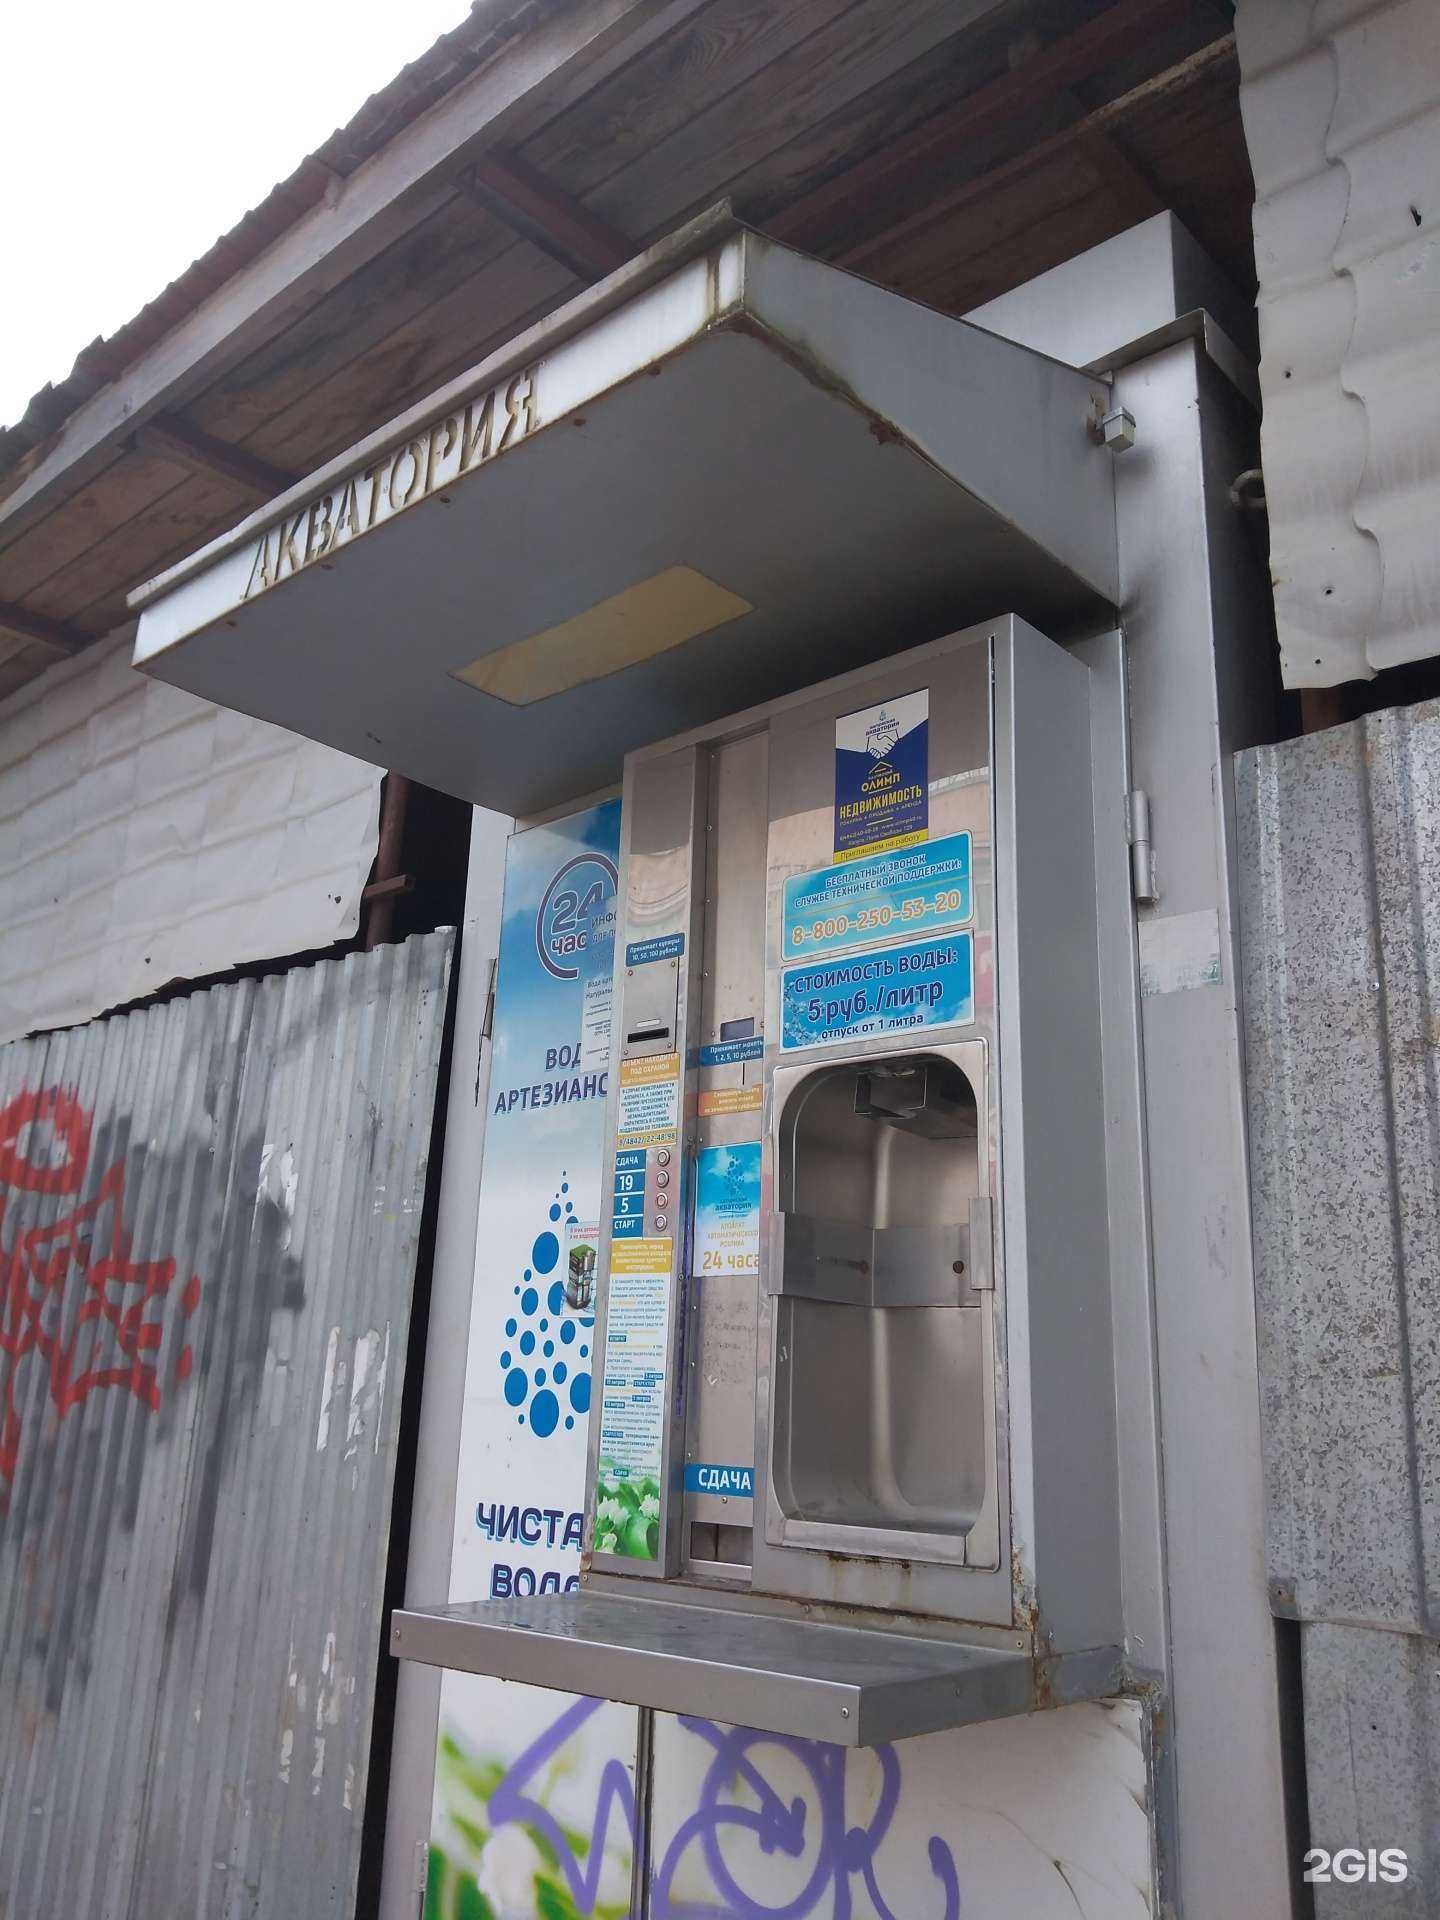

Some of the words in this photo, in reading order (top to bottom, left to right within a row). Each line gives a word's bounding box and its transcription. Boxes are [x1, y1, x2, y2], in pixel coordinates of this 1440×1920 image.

[242, 373, 538, 600] АКВАТОРИЯ
[861, 772, 900, 792] ОЛИМП
[840, 785, 922, 819] НЕДВИЖИМОСТЬ
[886, 840, 895, 848] на
[895, 832, 921, 849] работу
[826, 864, 886, 888] БЕСПЛАТНЫЙ
[888, 853, 927, 872] ЗВОНОК
[795, 893, 830, 908] СЛУЖБЕ
[831, 876, 895, 899] ТЕХНИЧЕСКОЙ
[897, 860, 962, 883] ПОДДЕРЖКИ:
[792, 889, 961, 945] 8-800-250-53-20
[794, 960, 894, 993] СТОИМОСТЬ
[898, 947, 959, 974] ВОДЫ:
[821, 1023, 859, 1040] отпуск
[861, 1021, 875, 1032] от
[878, 1020, 885, 1030] 1
[888, 1014, 924, 1028] литра
[616, 1156, 639, 1167] СДАЧА
[619, 1174, 634, 1191] 19
[620, 1197, 629, 1213] 5
[614, 1219, 636, 1230] СТАРТ
[702, 1250, 723, 1270] 24
[727, 1254, 760, 1269] часа
[698, 1468, 752, 1491] СДАЧА
[477, 1502, 584, 1551] ЧИСТА
